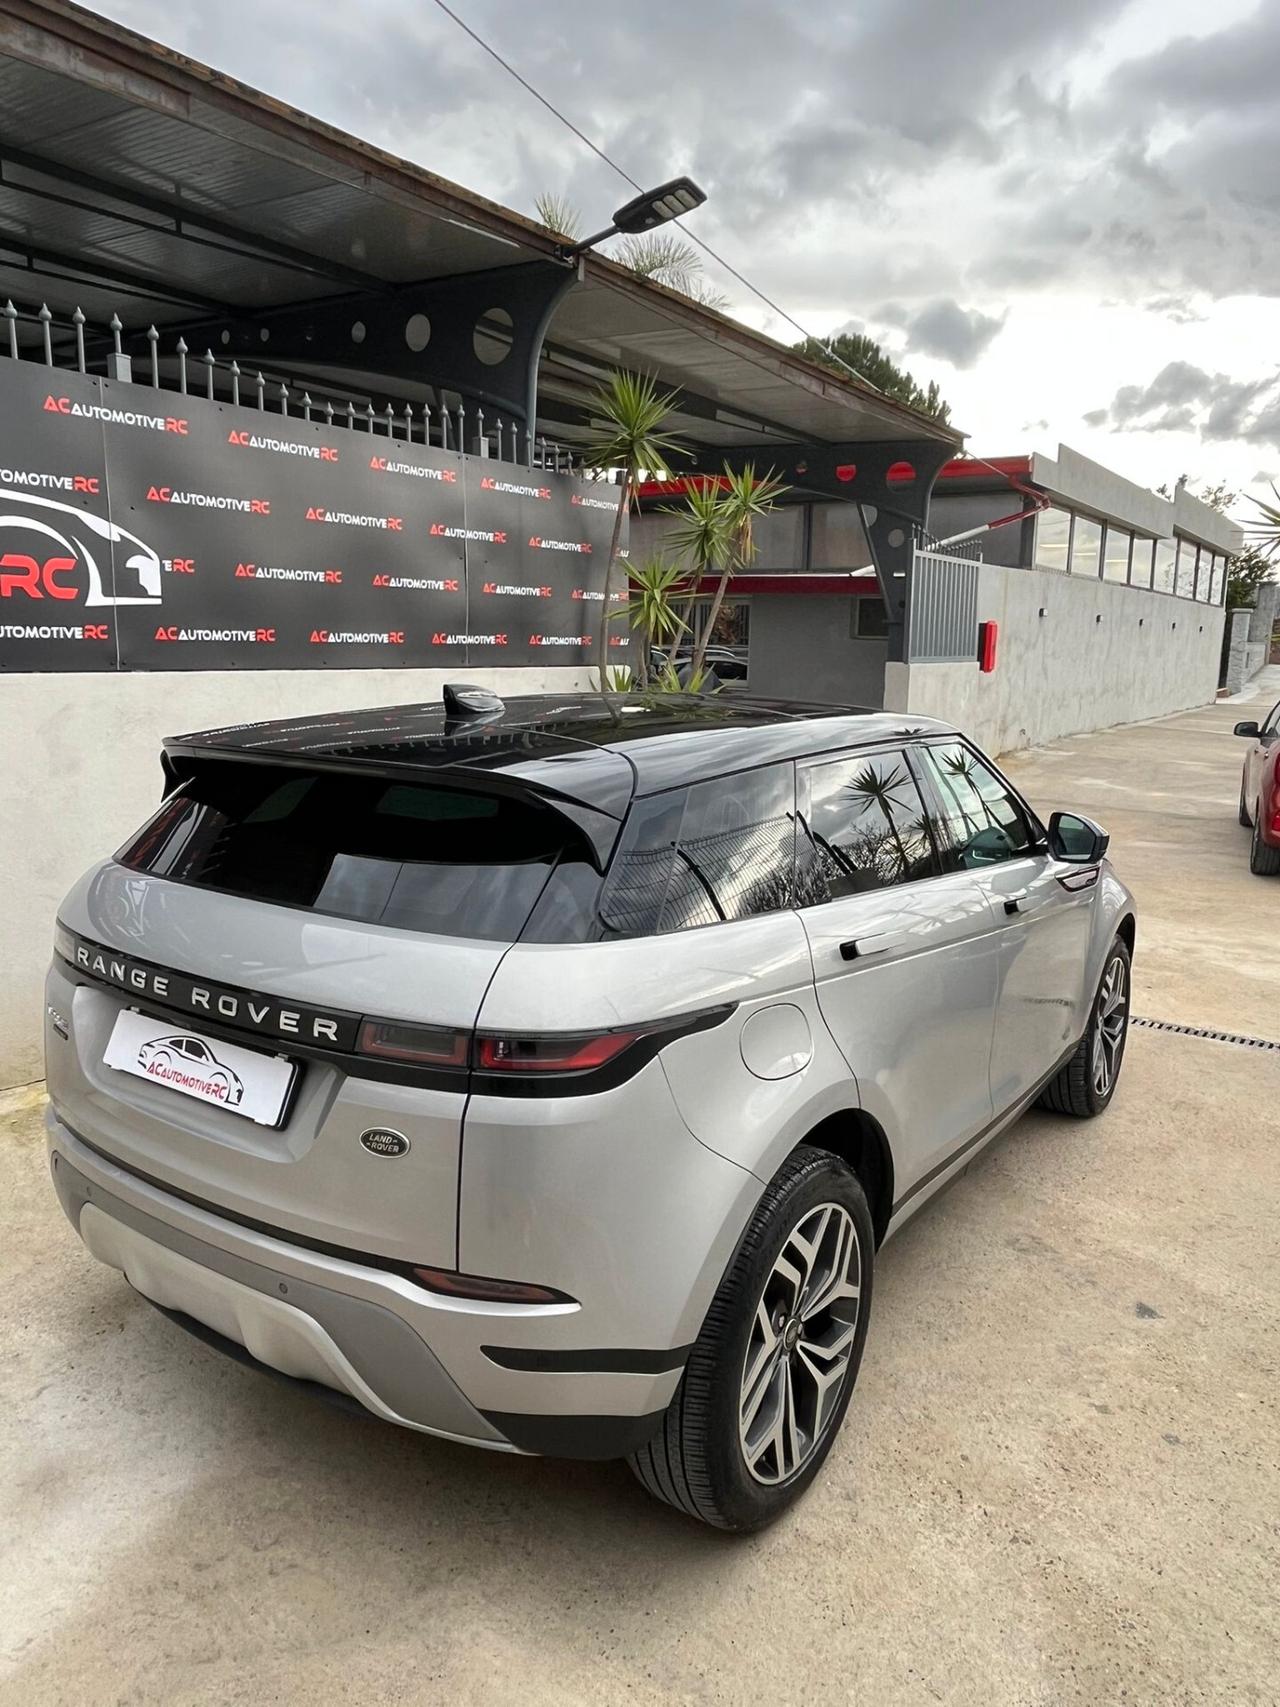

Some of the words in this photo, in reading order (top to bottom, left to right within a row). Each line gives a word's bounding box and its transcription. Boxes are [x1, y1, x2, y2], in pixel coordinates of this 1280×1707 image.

[43, 394, 189, 435] ACAUTOMOTIVERC
[228, 430, 338, 462] ACAUTOMOTIVERC
[369, 456, 456, 483] ACAUTOMOTIVERC
[480, 477, 551, 500] ACAUTOMOTIVERC
[146, 486, 271, 514] ACAUTOMOTIVERC
[305, 507, 402, 531] ACAUTOMOTIVERC
[429, 523, 506, 544] ACAUTOMOTIVERC
[528, 536, 592, 554] ACAUTOMOTIVERC
[235, 563, 342, 585] ACAUTOMOTIVERC
[372, 574, 458, 592] ACAUTOMOTIVERC
[482, 583, 552, 598] ACAUTOMOTIVERC
[154, 626, 276, 643] ACAUTOMOTIVERC
[310, 630, 404, 644] ACAUTOMOTIVERC
[432, 632, 508, 646] ACAUTOMOTIVERC
[529, 634, 592, 647] ACAUTOMOTIVERC
[76, 946, 169, 997] RANGE
[191, 987, 339, 1042] ROVER
[146, 1061, 227, 1100] ACAUTOMOTIVERC
